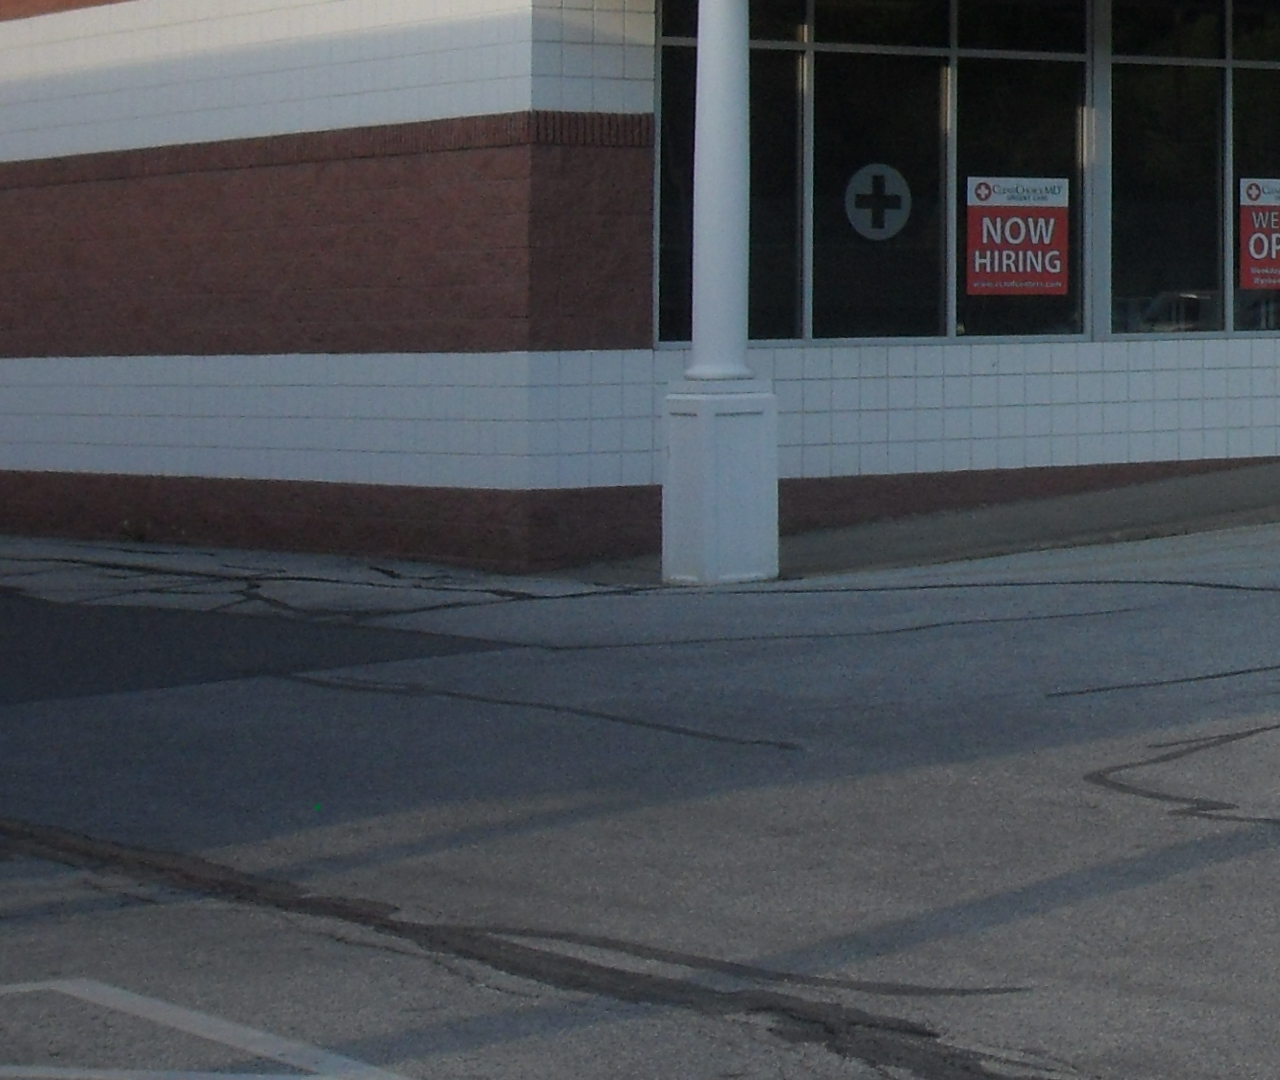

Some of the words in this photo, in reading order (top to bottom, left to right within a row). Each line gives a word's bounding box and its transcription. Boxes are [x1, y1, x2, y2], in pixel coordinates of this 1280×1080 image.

[981, 217, 1055, 245] NOW
[1252, 211, 1280, 229] WE
[974, 250, 1061, 273] HIRING
